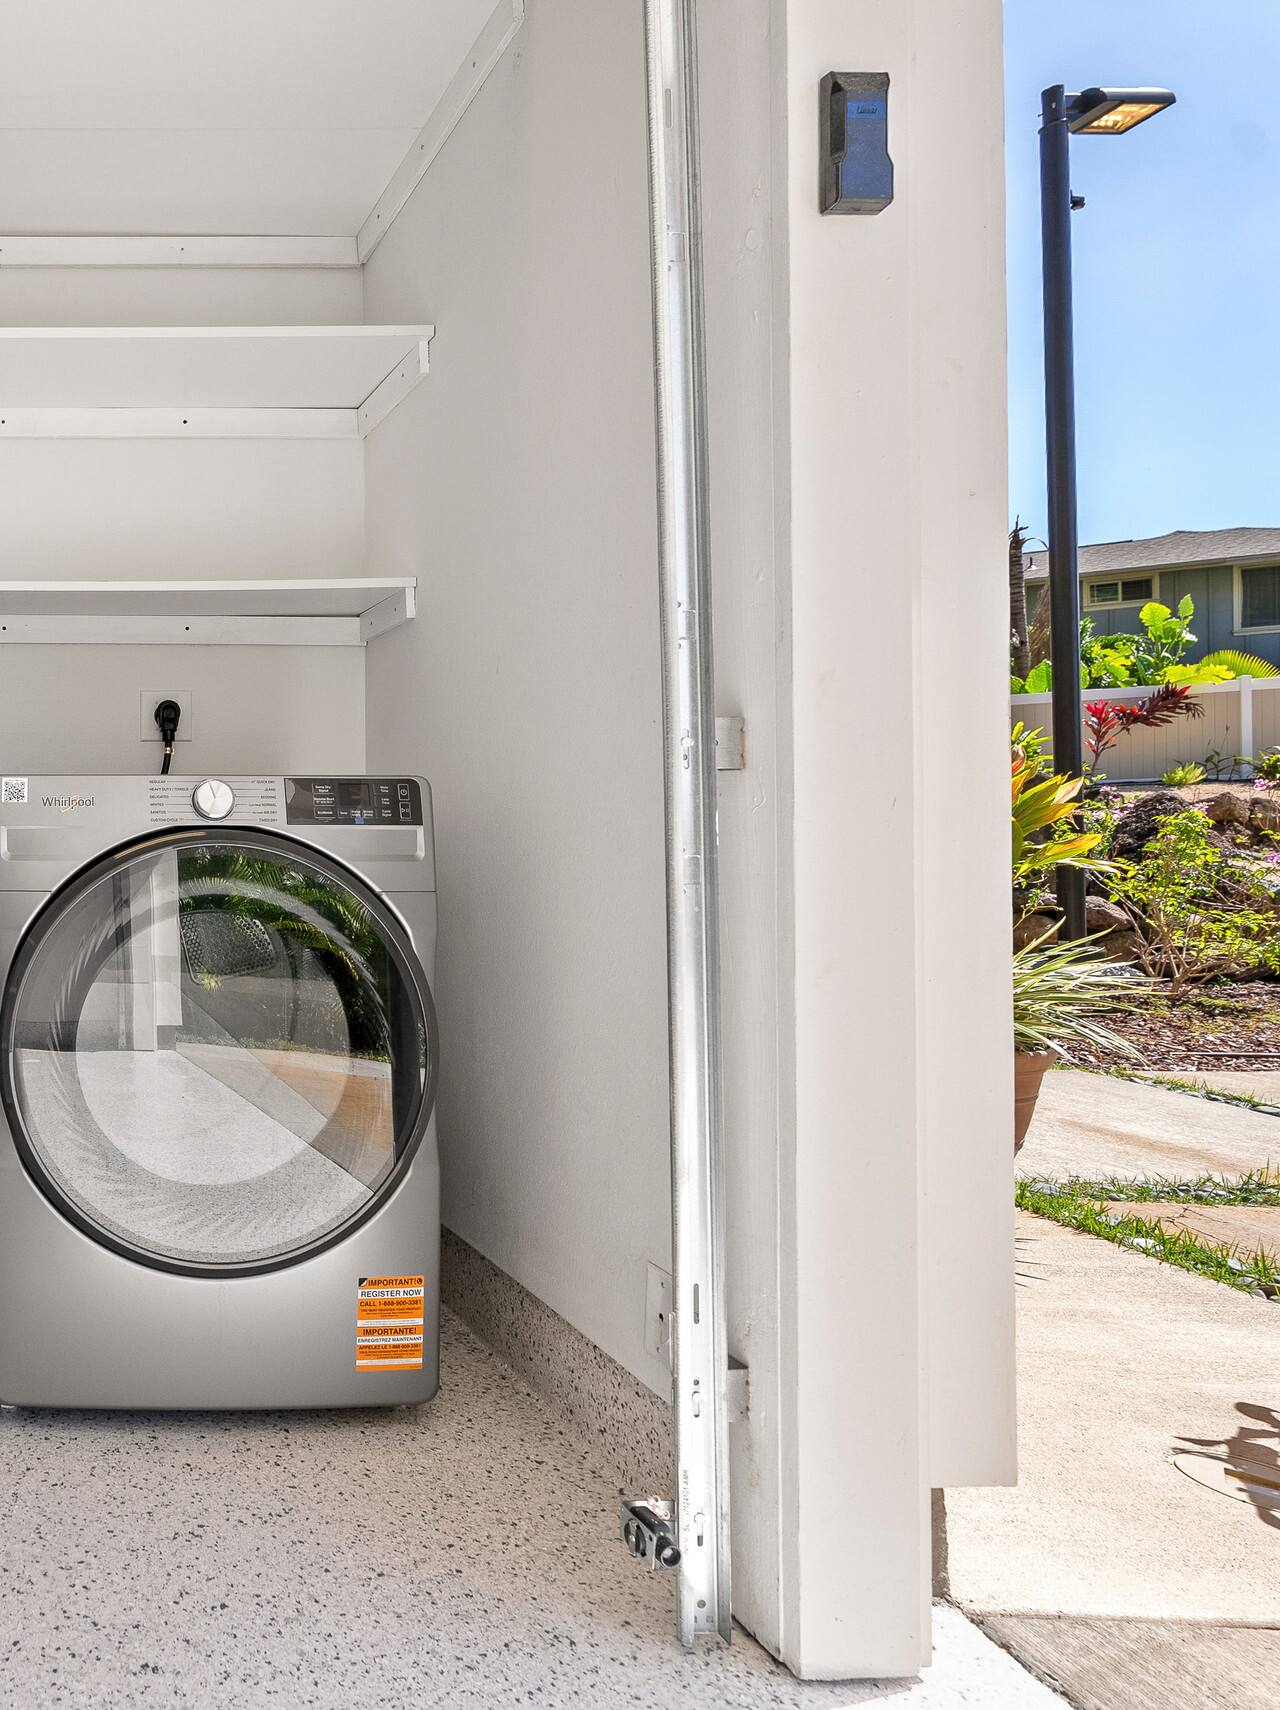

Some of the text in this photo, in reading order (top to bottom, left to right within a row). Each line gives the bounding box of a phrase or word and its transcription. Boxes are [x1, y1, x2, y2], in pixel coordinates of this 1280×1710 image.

[42, 796, 95, 810] Whirlpool
[361, 1290, 401, 1298] REGISTER
[363, 1327, 417, 1336] IMPORTANTE!
